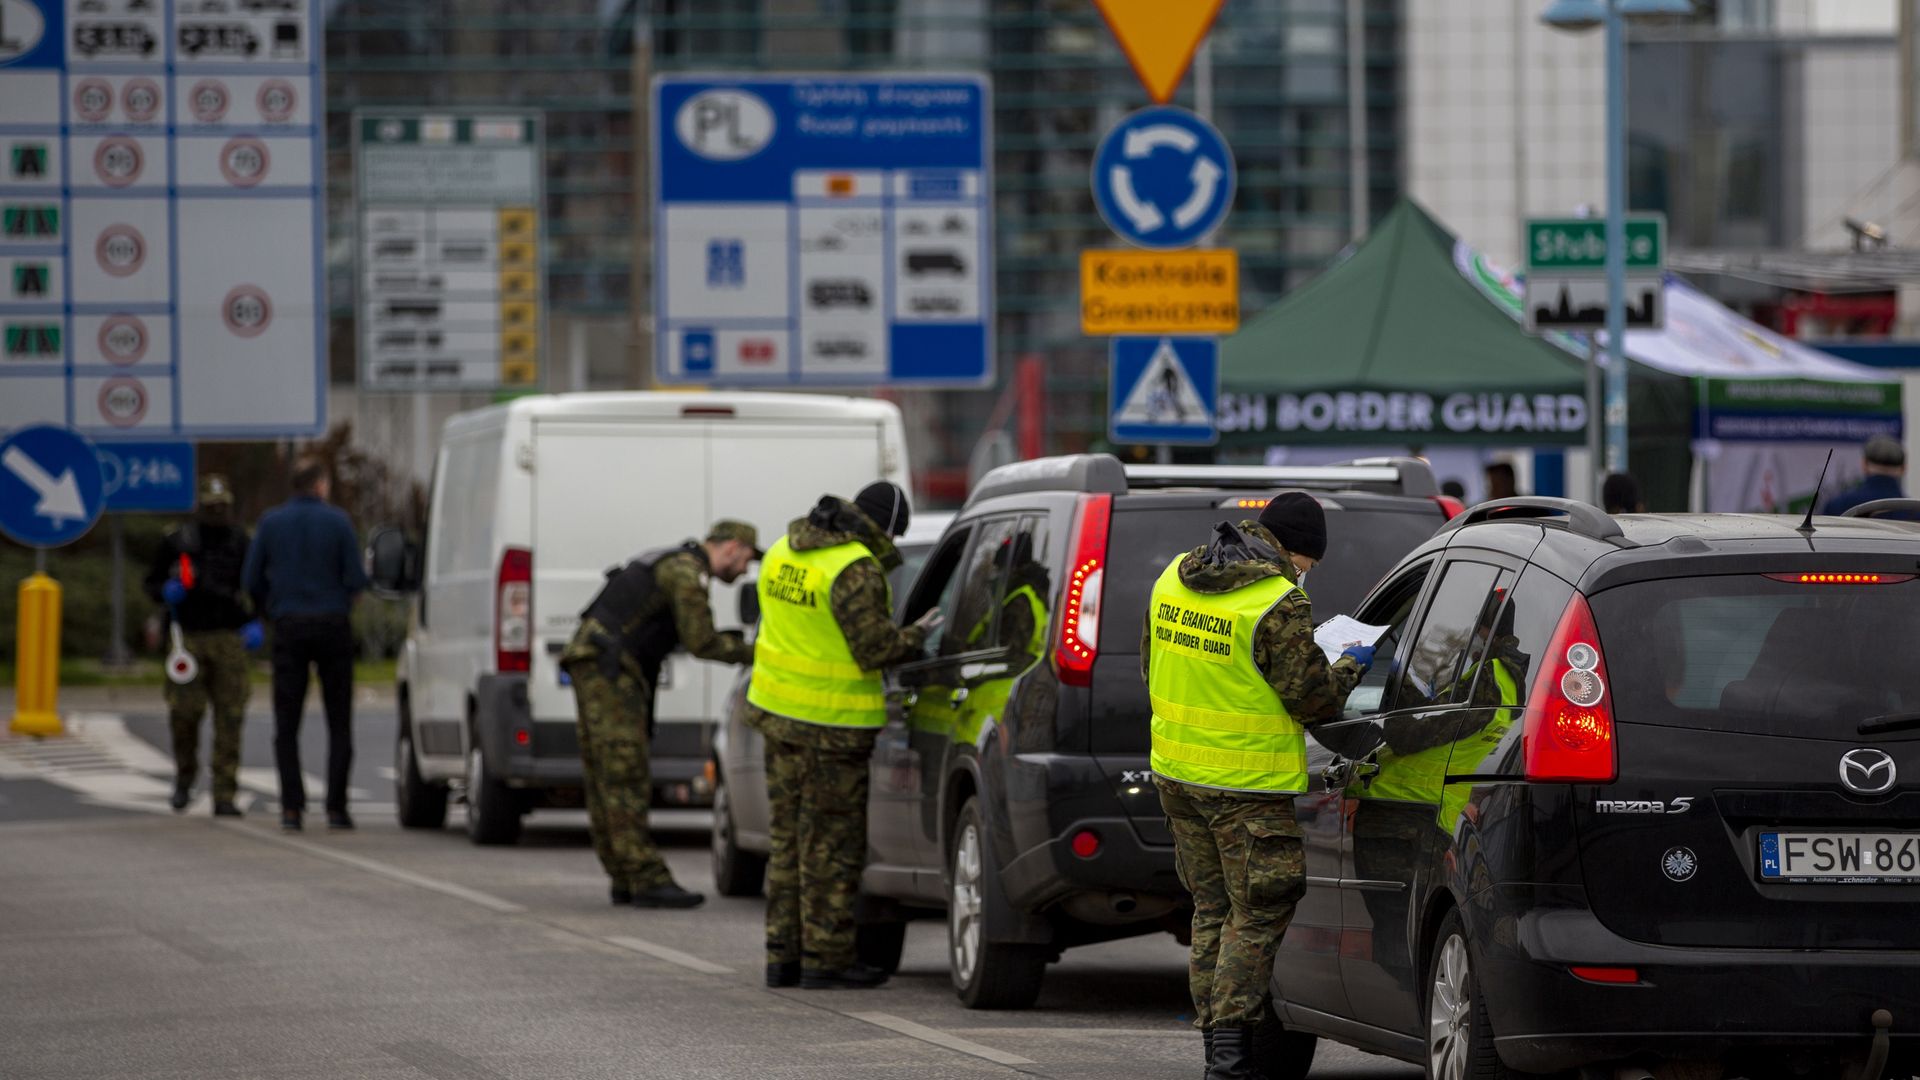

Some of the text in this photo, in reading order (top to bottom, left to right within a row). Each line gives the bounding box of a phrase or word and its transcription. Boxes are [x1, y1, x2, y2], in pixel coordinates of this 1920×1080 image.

[693, 99, 752, 149] PL
[1535, 228, 1653, 261] Słube
[1092, 258, 1227, 288] Kontrola
[1083, 295, 1238, 325] Graniczna
[1216, 391, 1588, 432] SH BORDER GUARD
[1181, 609, 1233, 638] GRANICZNA
[1155, 625, 1231, 657] POLISH BORDER GUARD
[1595, 796, 1695, 814] mazda 5
[1765, 859, 1778, 869] PL
[1784, 837, 1920, 872] FSW 86
